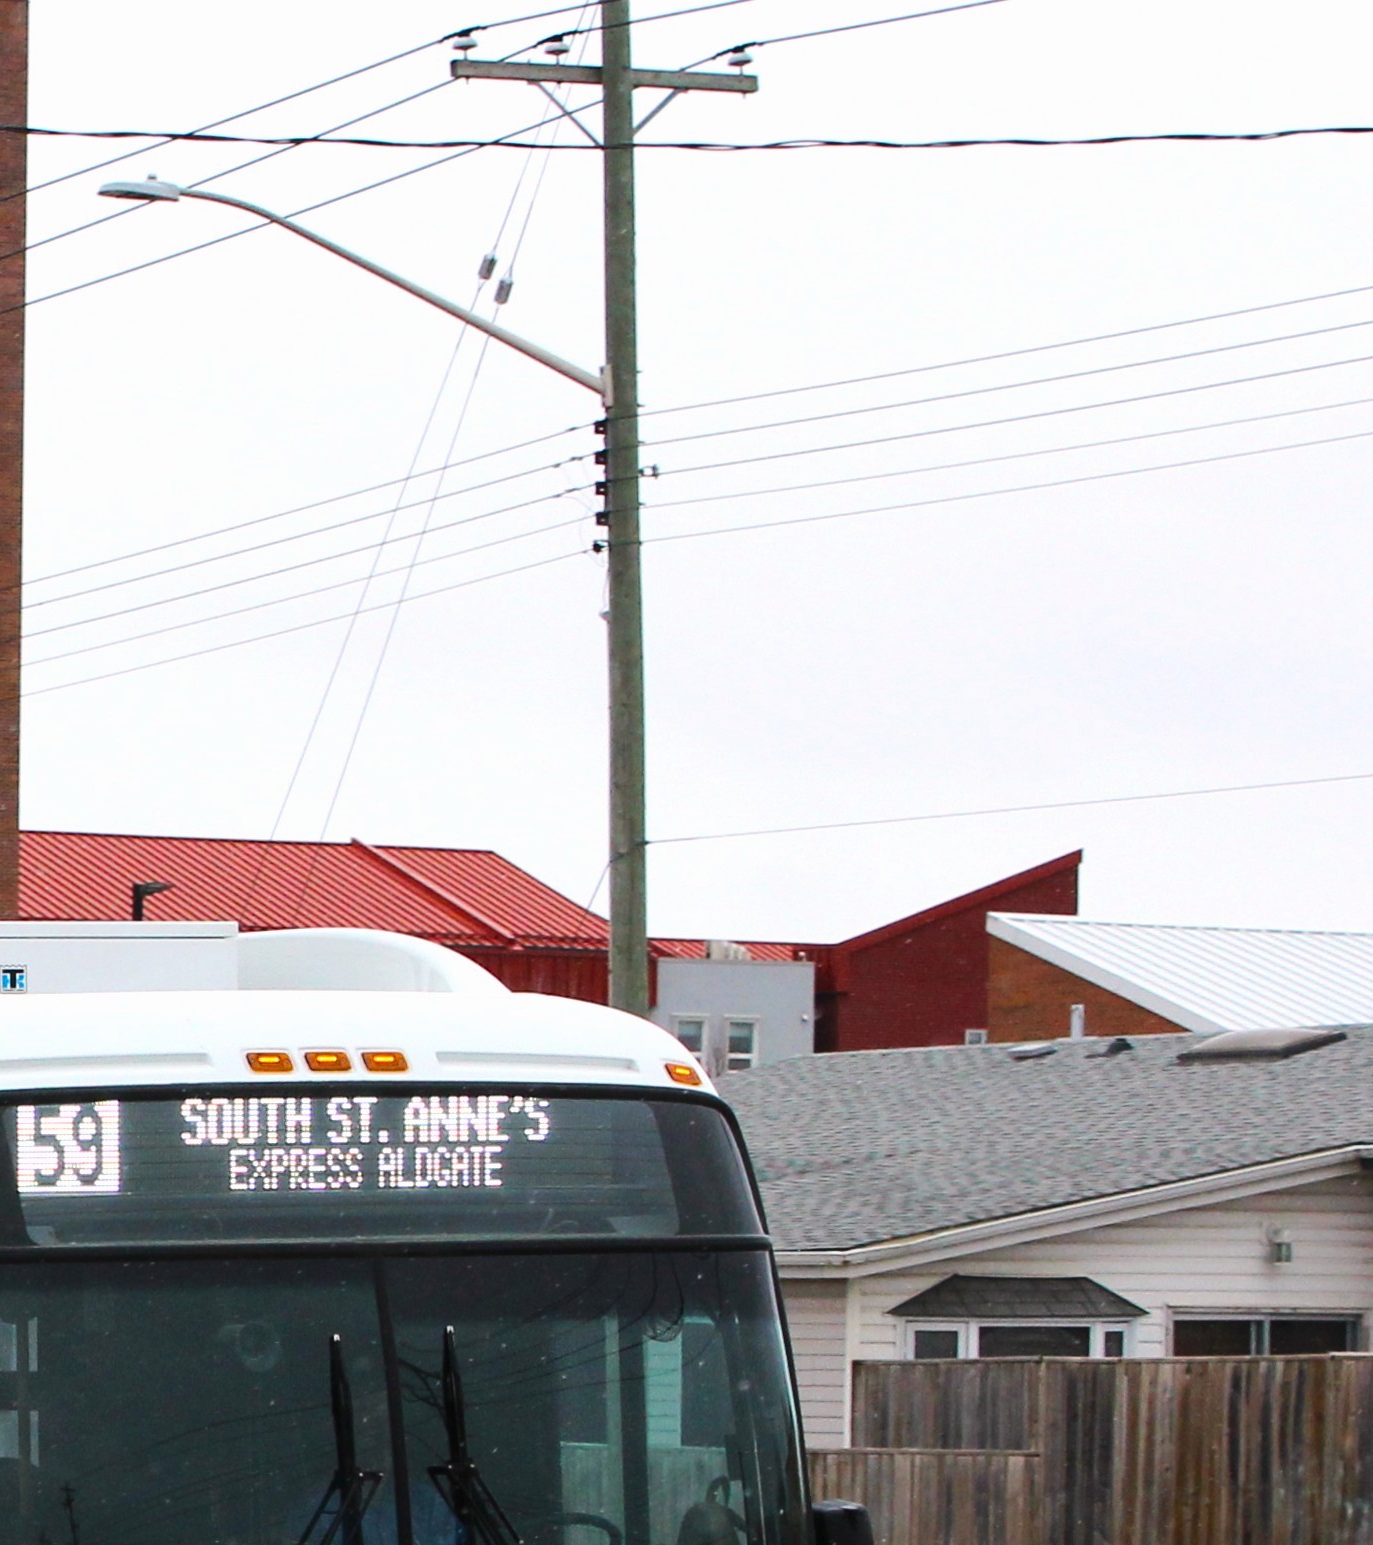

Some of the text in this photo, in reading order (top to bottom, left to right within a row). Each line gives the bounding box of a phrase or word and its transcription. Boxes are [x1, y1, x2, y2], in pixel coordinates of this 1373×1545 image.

[32, 1104, 105, 1185] 59
[181, 1095, 550, 1145] SOUTH ST. ANNE'S
[229, 1147, 363, 1191] EXPRESS
